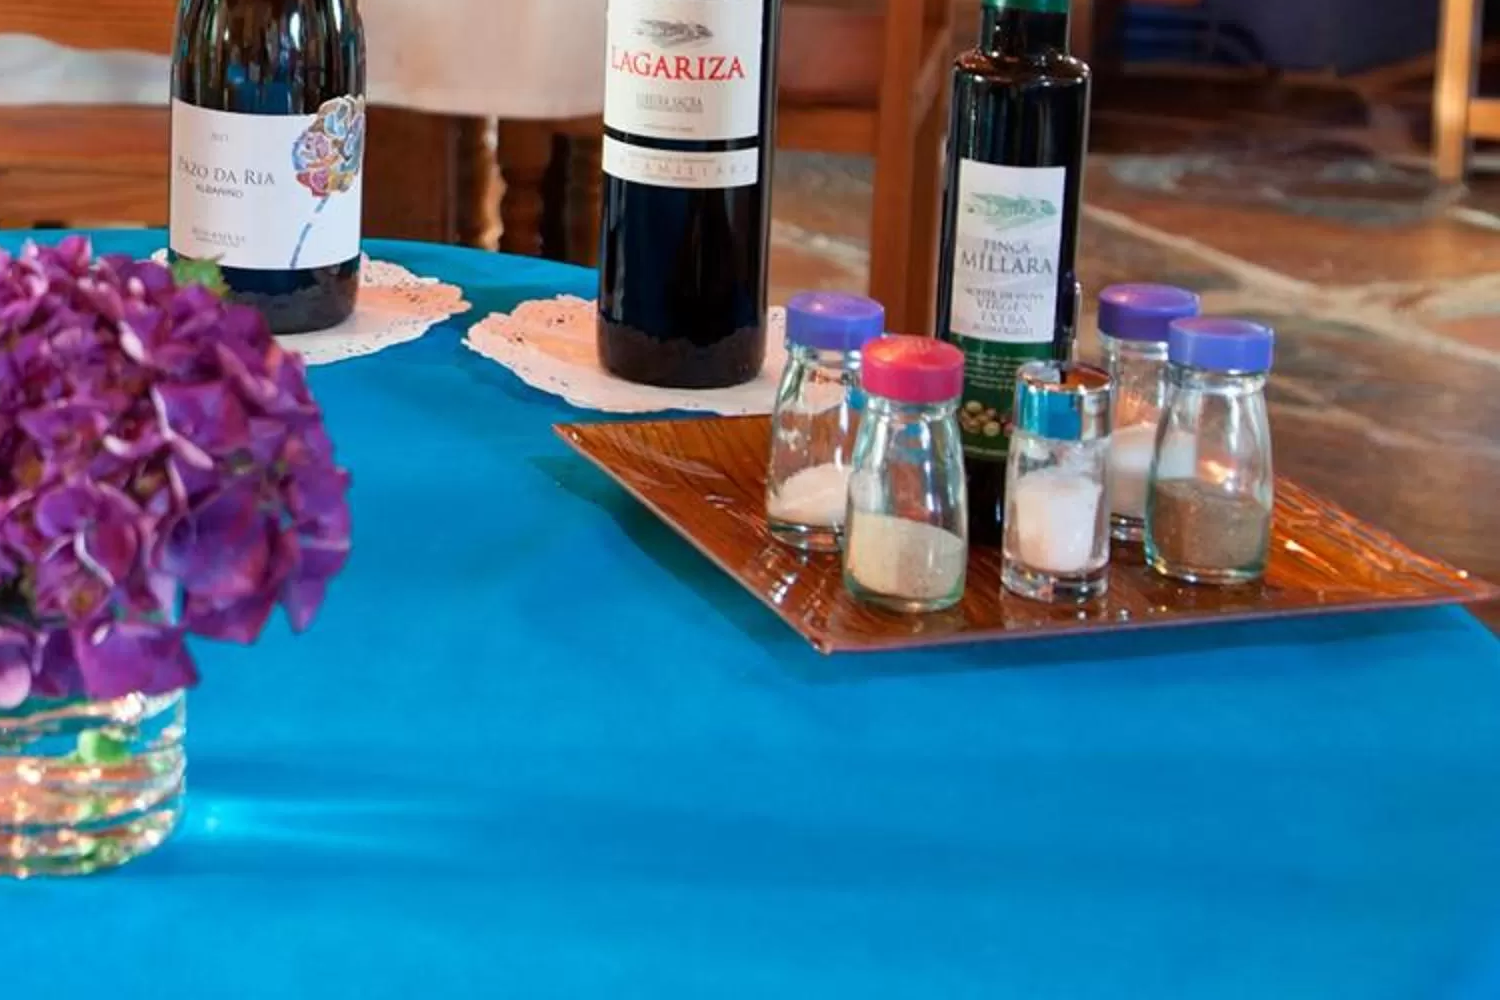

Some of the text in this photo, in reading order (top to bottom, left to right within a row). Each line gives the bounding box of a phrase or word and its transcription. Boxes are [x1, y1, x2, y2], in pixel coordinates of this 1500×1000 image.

[611, 45, 745, 80] LAGARIZA
[214, 168, 237, 185] DA
[244, 169, 276, 186] RIA
[983, 239, 1031, 254] FINCA
[961, 250, 1052, 274] MILLARA
